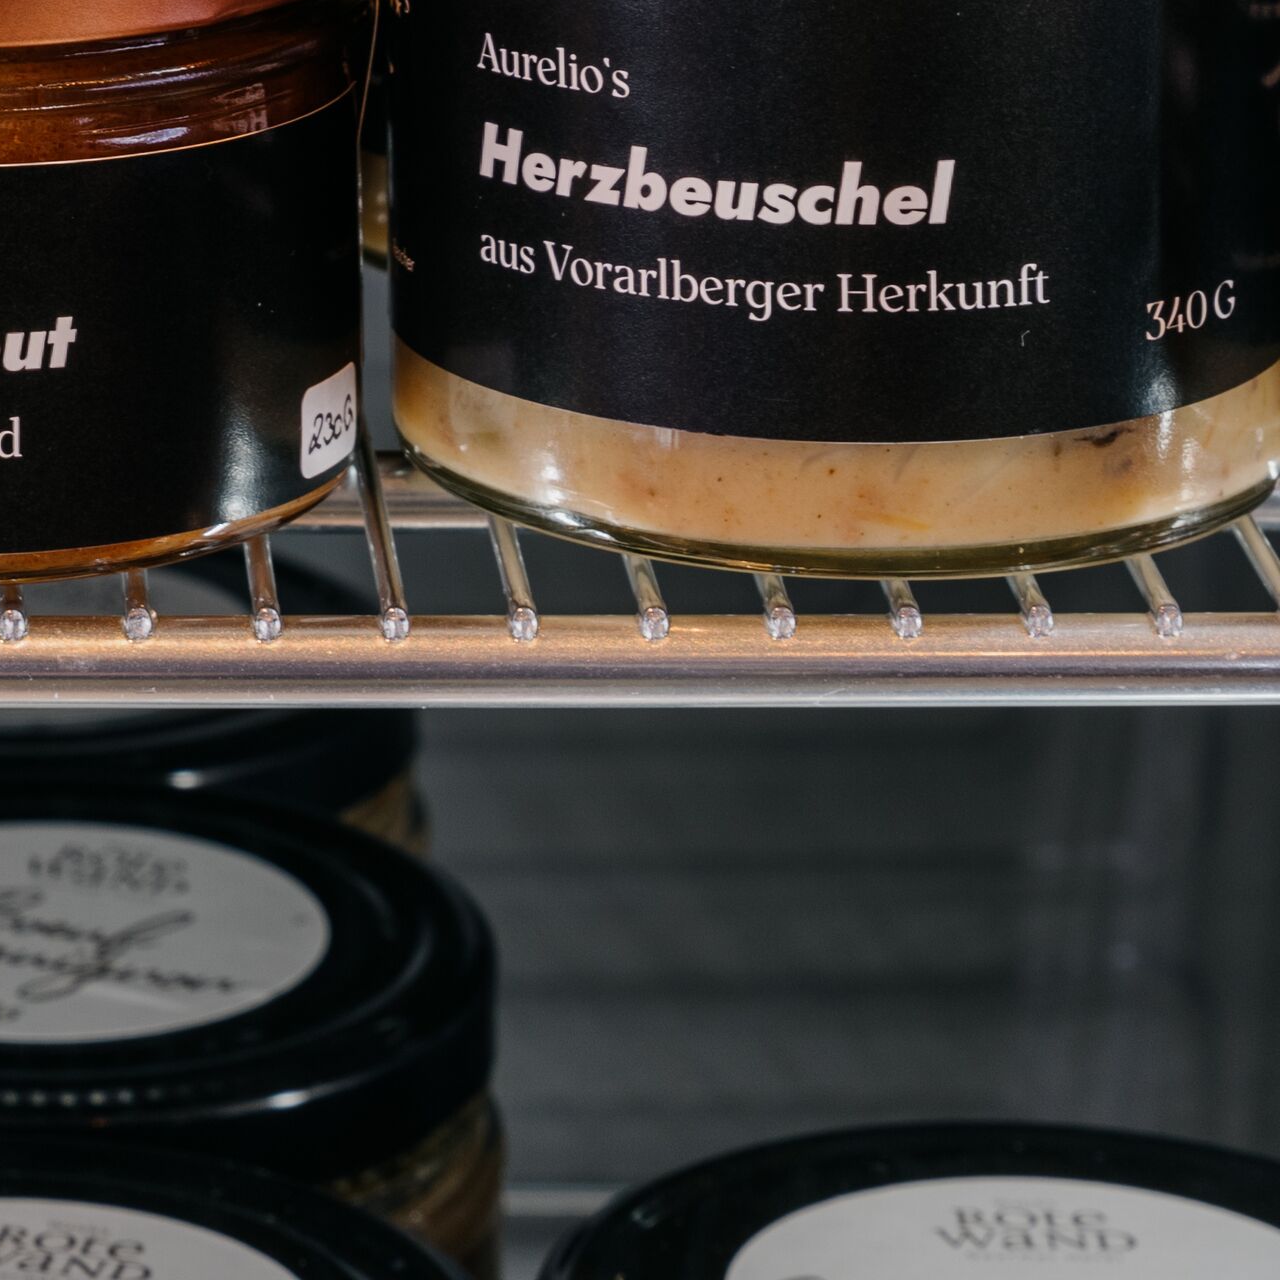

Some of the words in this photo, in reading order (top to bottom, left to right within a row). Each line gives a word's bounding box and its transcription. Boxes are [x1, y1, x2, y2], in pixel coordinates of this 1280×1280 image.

[480, 122, 955, 225] Herzbeuschel
[481, 235, 535, 273] aus
[543, 241, 824, 321] Vorarlberger
[837, 263, 1050, 312] Herkunft
